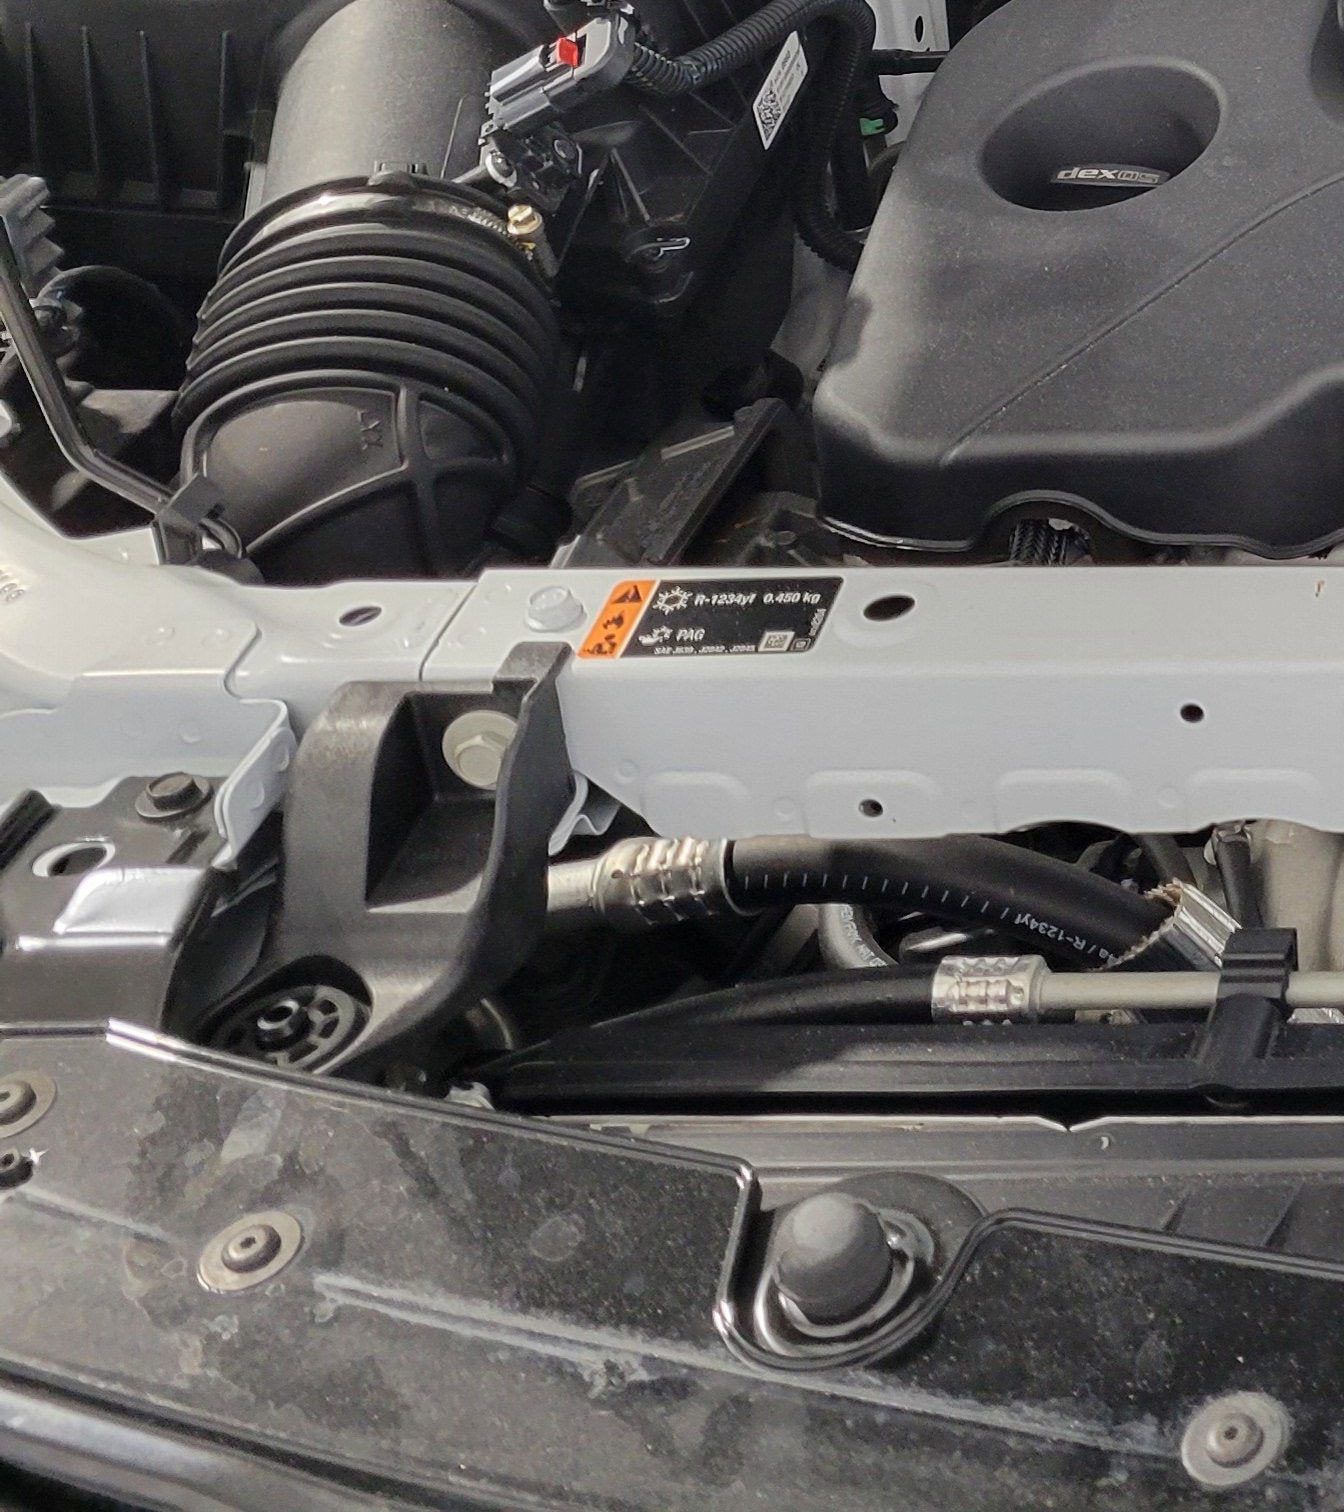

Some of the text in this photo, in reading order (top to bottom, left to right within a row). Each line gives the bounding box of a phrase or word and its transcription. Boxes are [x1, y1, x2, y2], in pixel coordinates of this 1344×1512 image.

[693, 592, 821, 607] R-1234yf 0.450 kg
[676, 628, 706, 642] PAG
